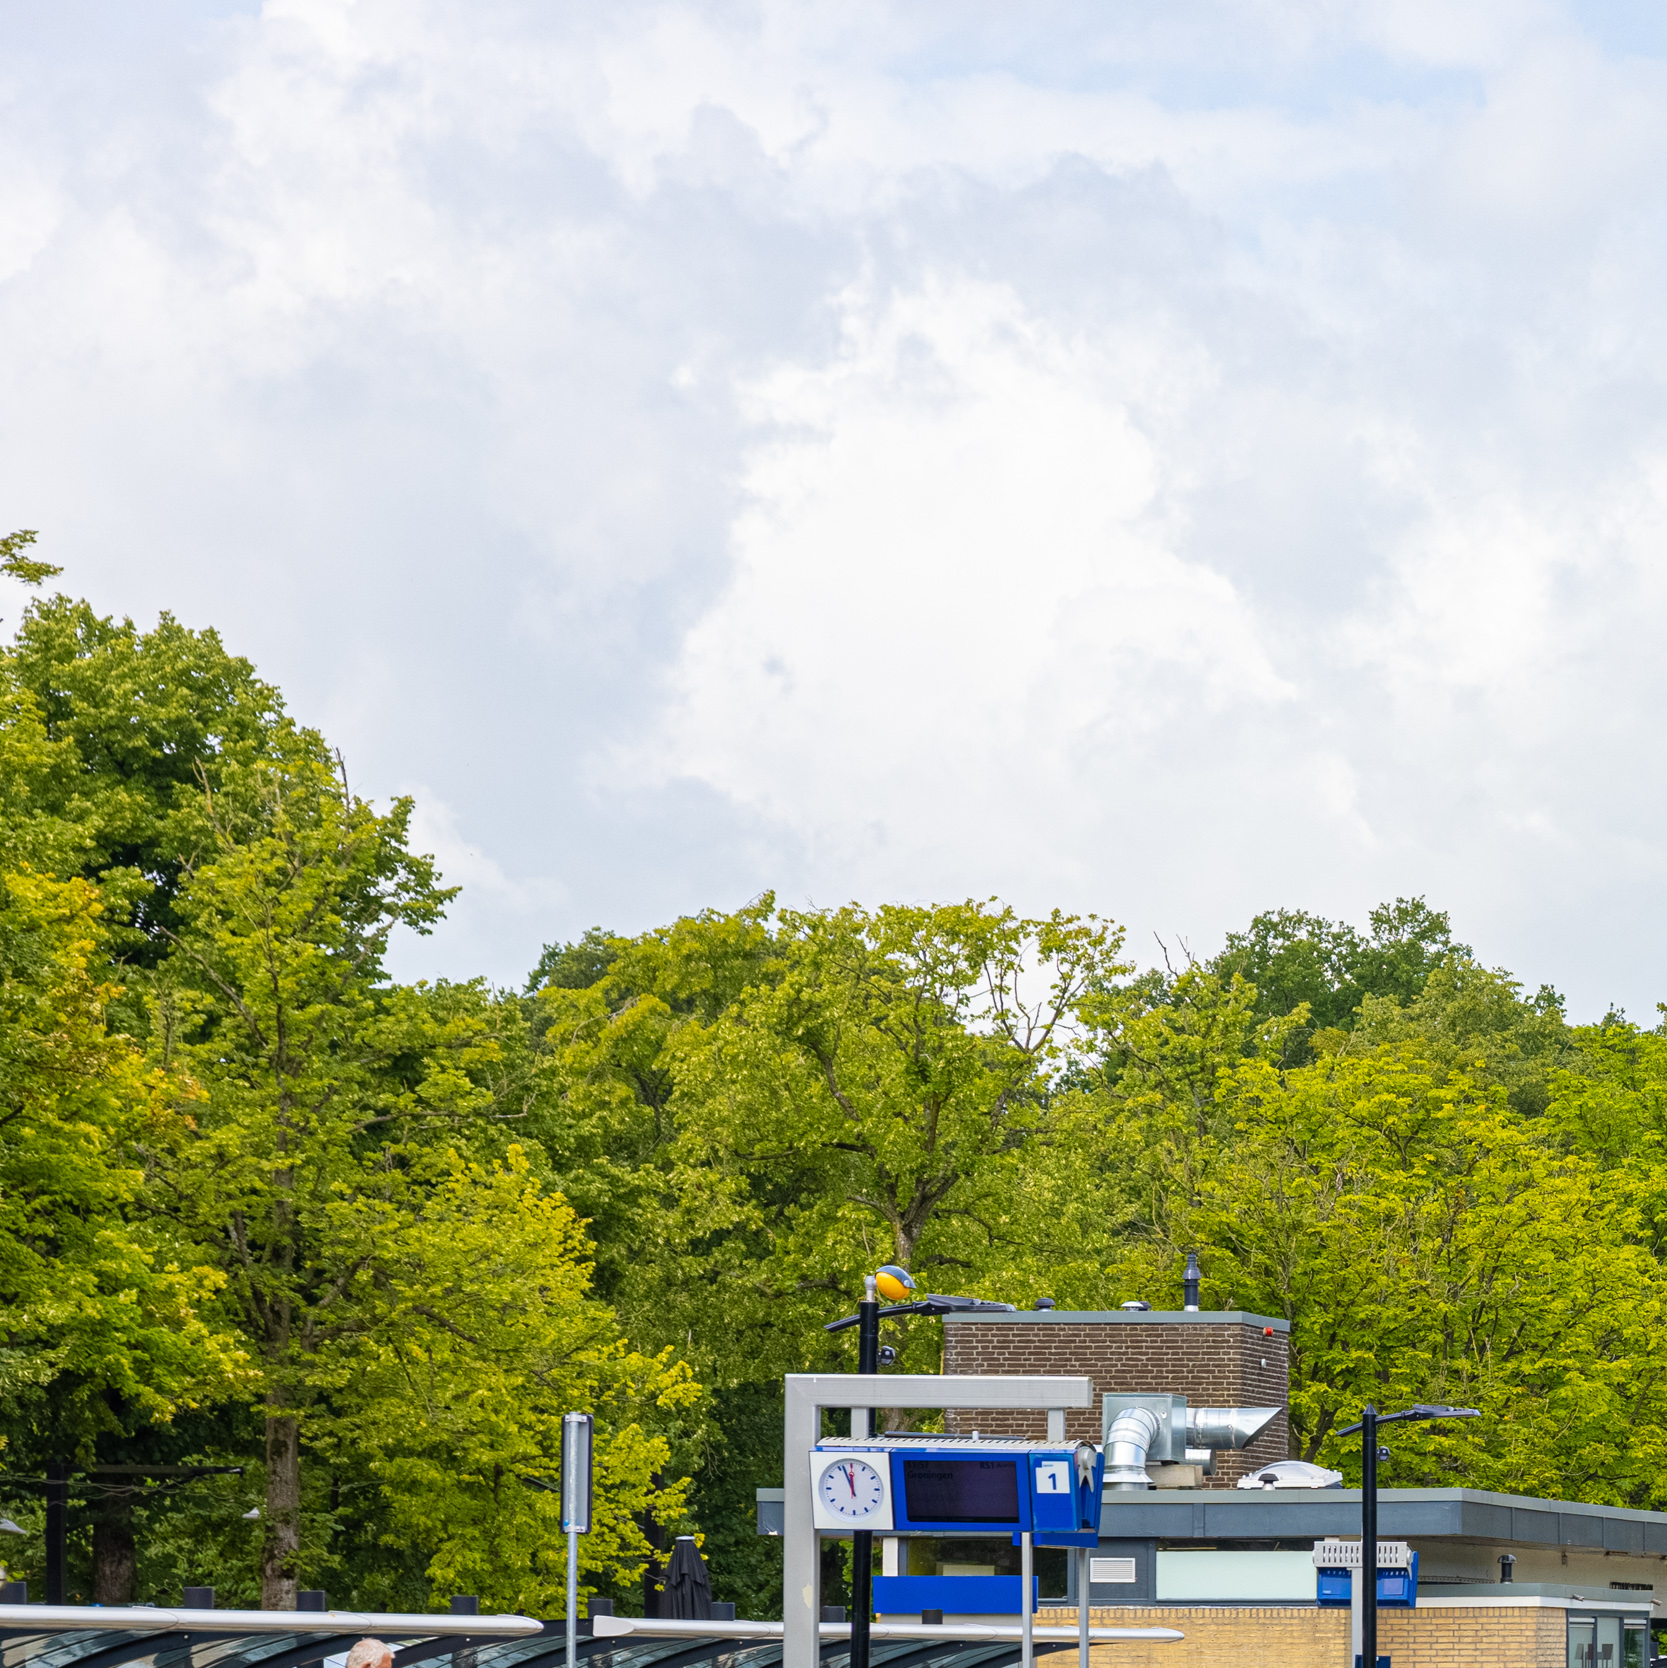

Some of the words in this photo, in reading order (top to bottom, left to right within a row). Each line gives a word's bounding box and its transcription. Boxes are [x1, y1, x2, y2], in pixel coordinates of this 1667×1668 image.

[980, 1461, 995, 1469] RS1
[907, 1471, 953, 1481] Groningen
[1047, 1473, 1057, 1490] 1
